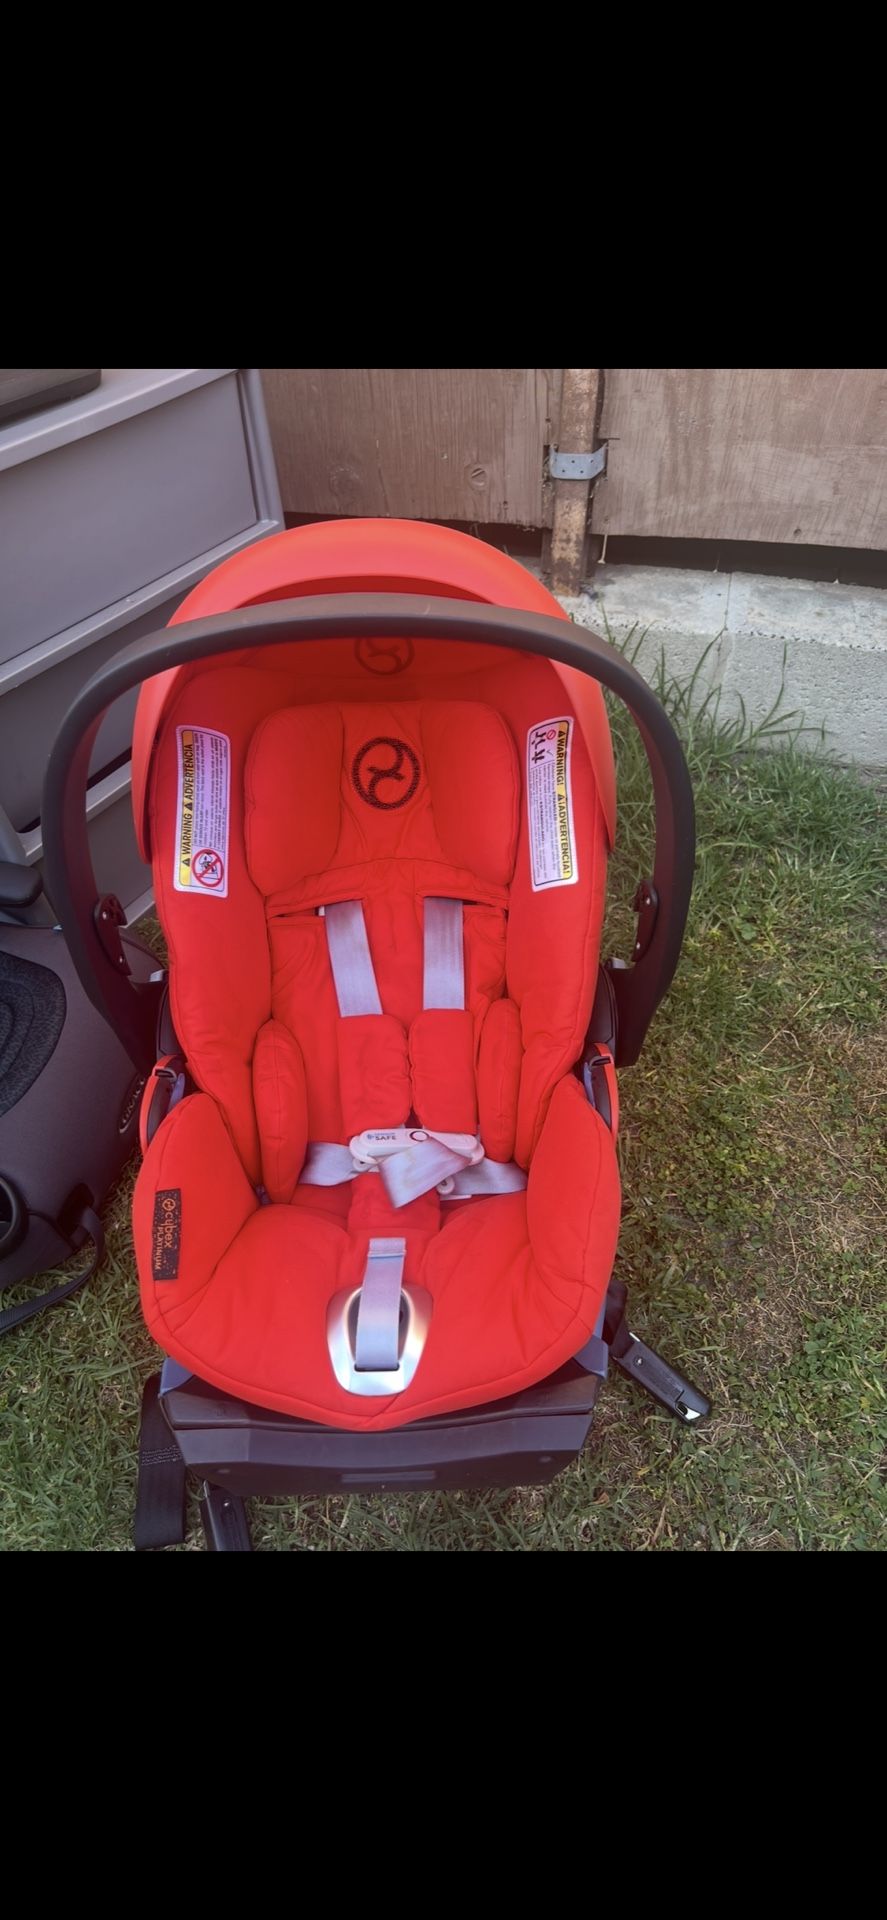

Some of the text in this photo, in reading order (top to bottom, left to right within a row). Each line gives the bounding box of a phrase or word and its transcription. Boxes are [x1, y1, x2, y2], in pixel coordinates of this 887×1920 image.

[556, 737, 565, 786] WARNING!
[181, 743, 194, 855] WARNING ADVERTENCIA
[154, 1226, 164, 1270] PLATINUM
[160, 1211, 178, 1249] cybex
